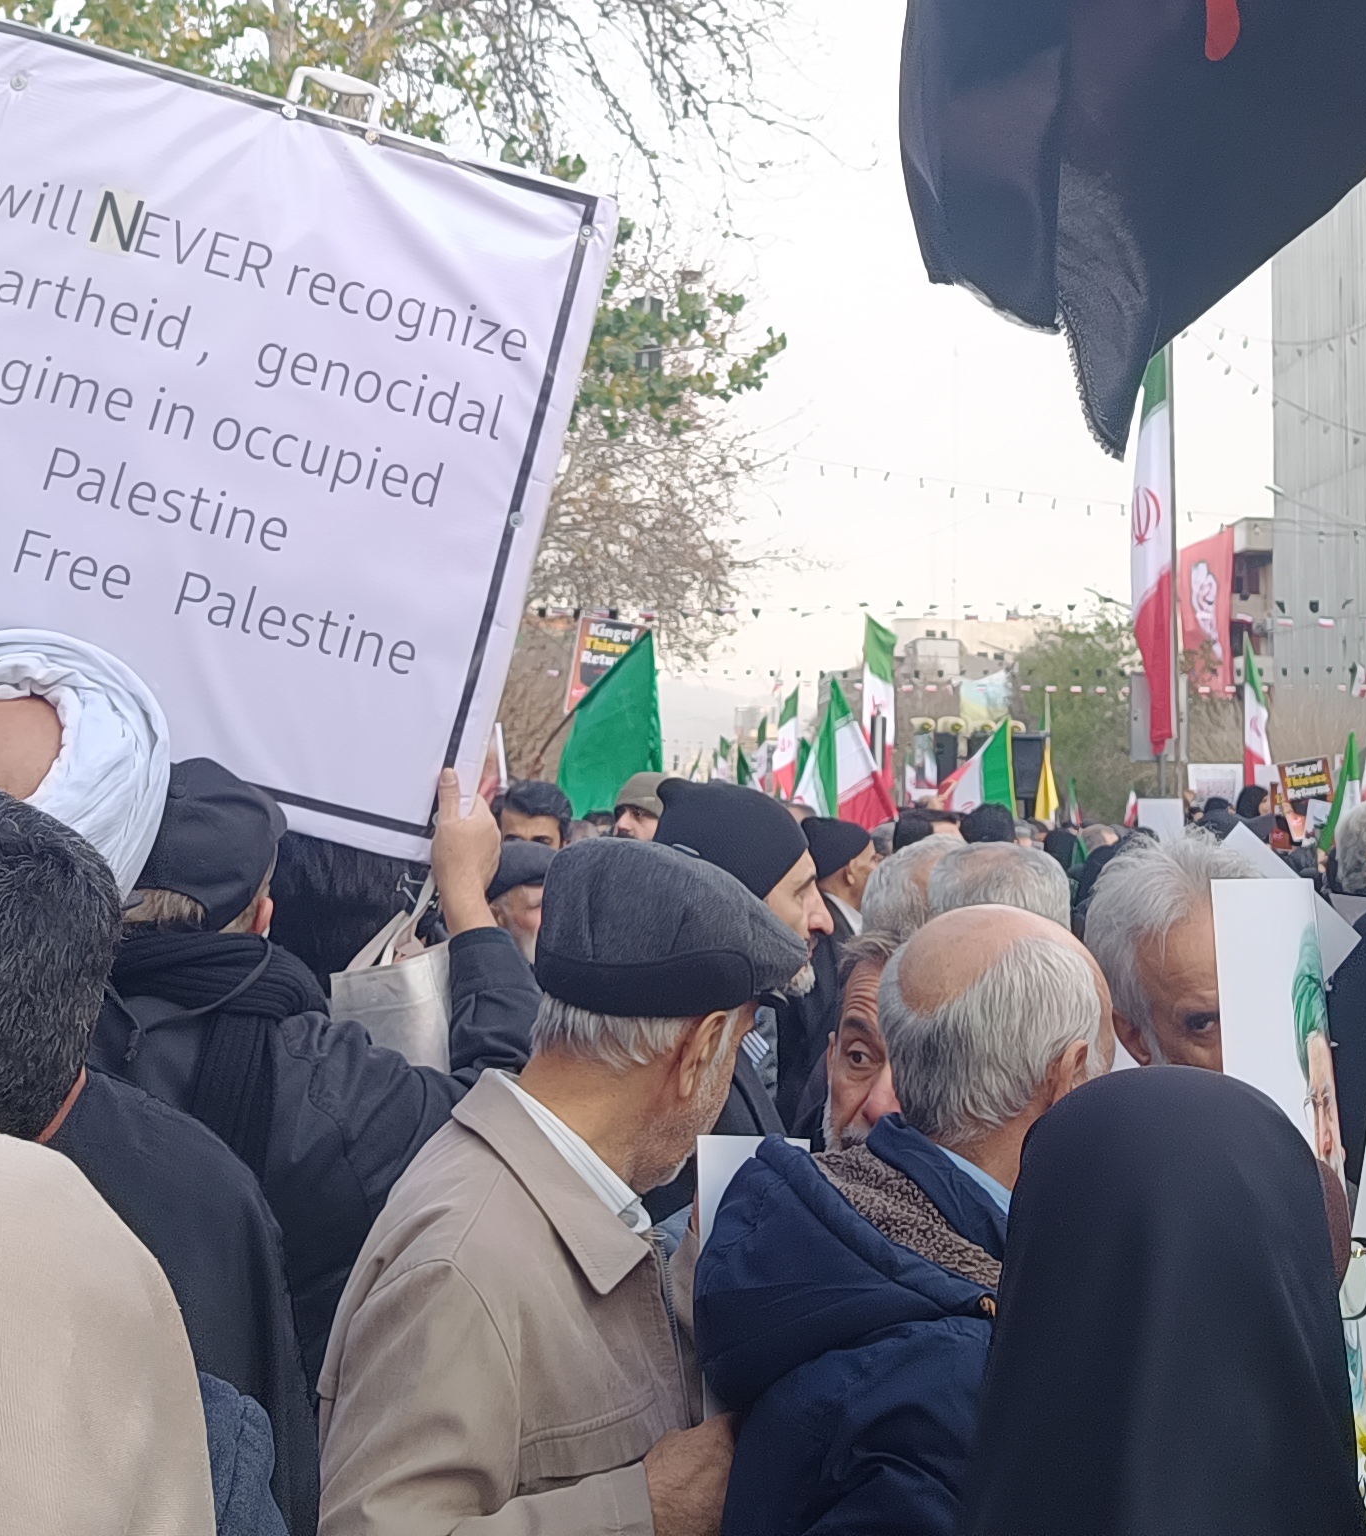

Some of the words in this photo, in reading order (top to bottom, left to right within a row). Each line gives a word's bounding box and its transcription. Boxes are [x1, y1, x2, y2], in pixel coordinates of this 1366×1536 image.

[90, 190, 273, 289] NEVER
[286, 265, 528, 362] recognize
[149, 388, 195, 441] in
[212, 416, 445, 508] occupied
[255, 341, 504, 441] genocidal
[43, 446, 289, 552] Palestine
[13, 528, 132, 600] Free
[174, 571, 417, 675] Palestine
